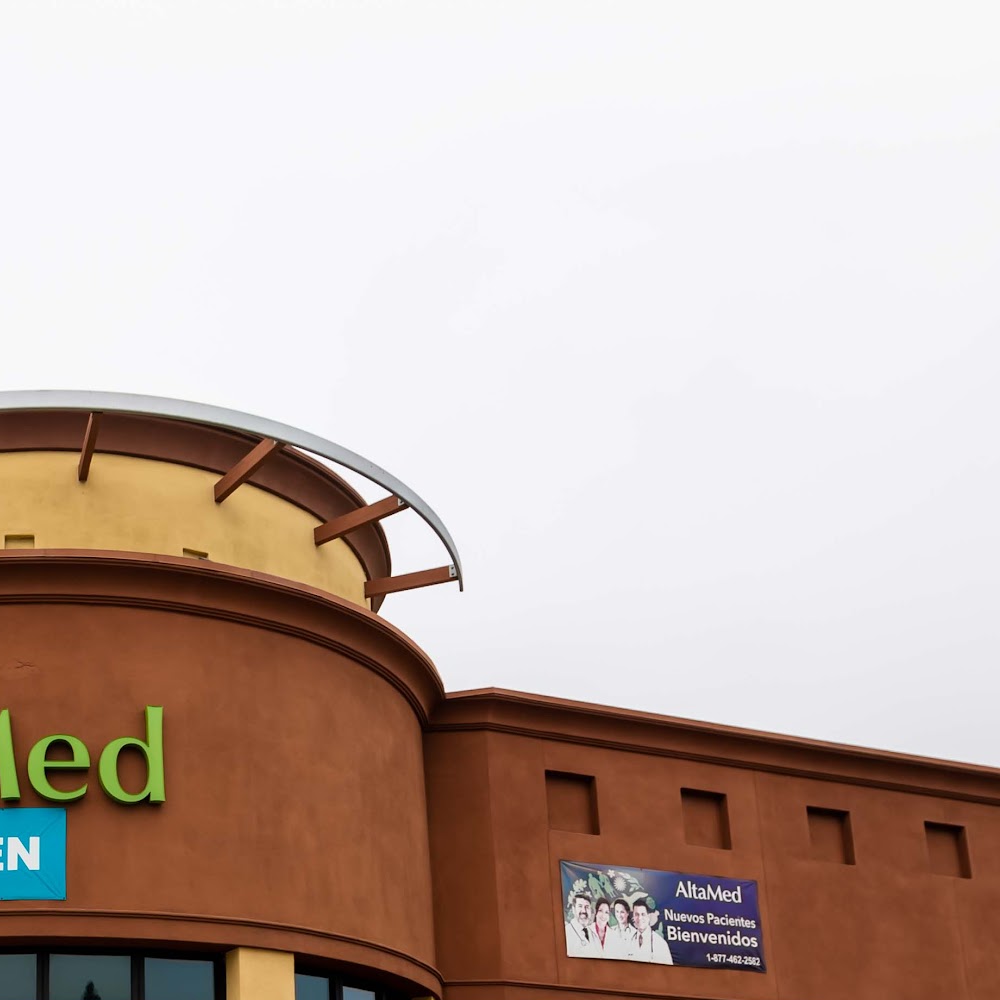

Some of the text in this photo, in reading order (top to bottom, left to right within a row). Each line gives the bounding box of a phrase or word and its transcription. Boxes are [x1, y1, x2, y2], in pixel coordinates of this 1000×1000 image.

[675, 880, 742, 904] AltaMed
[664, 908, 756, 929] Nuevos Pacientes
[666, 925, 759, 948] Bienvenidos
[706, 952, 761, 966] 1-877-462-2582
